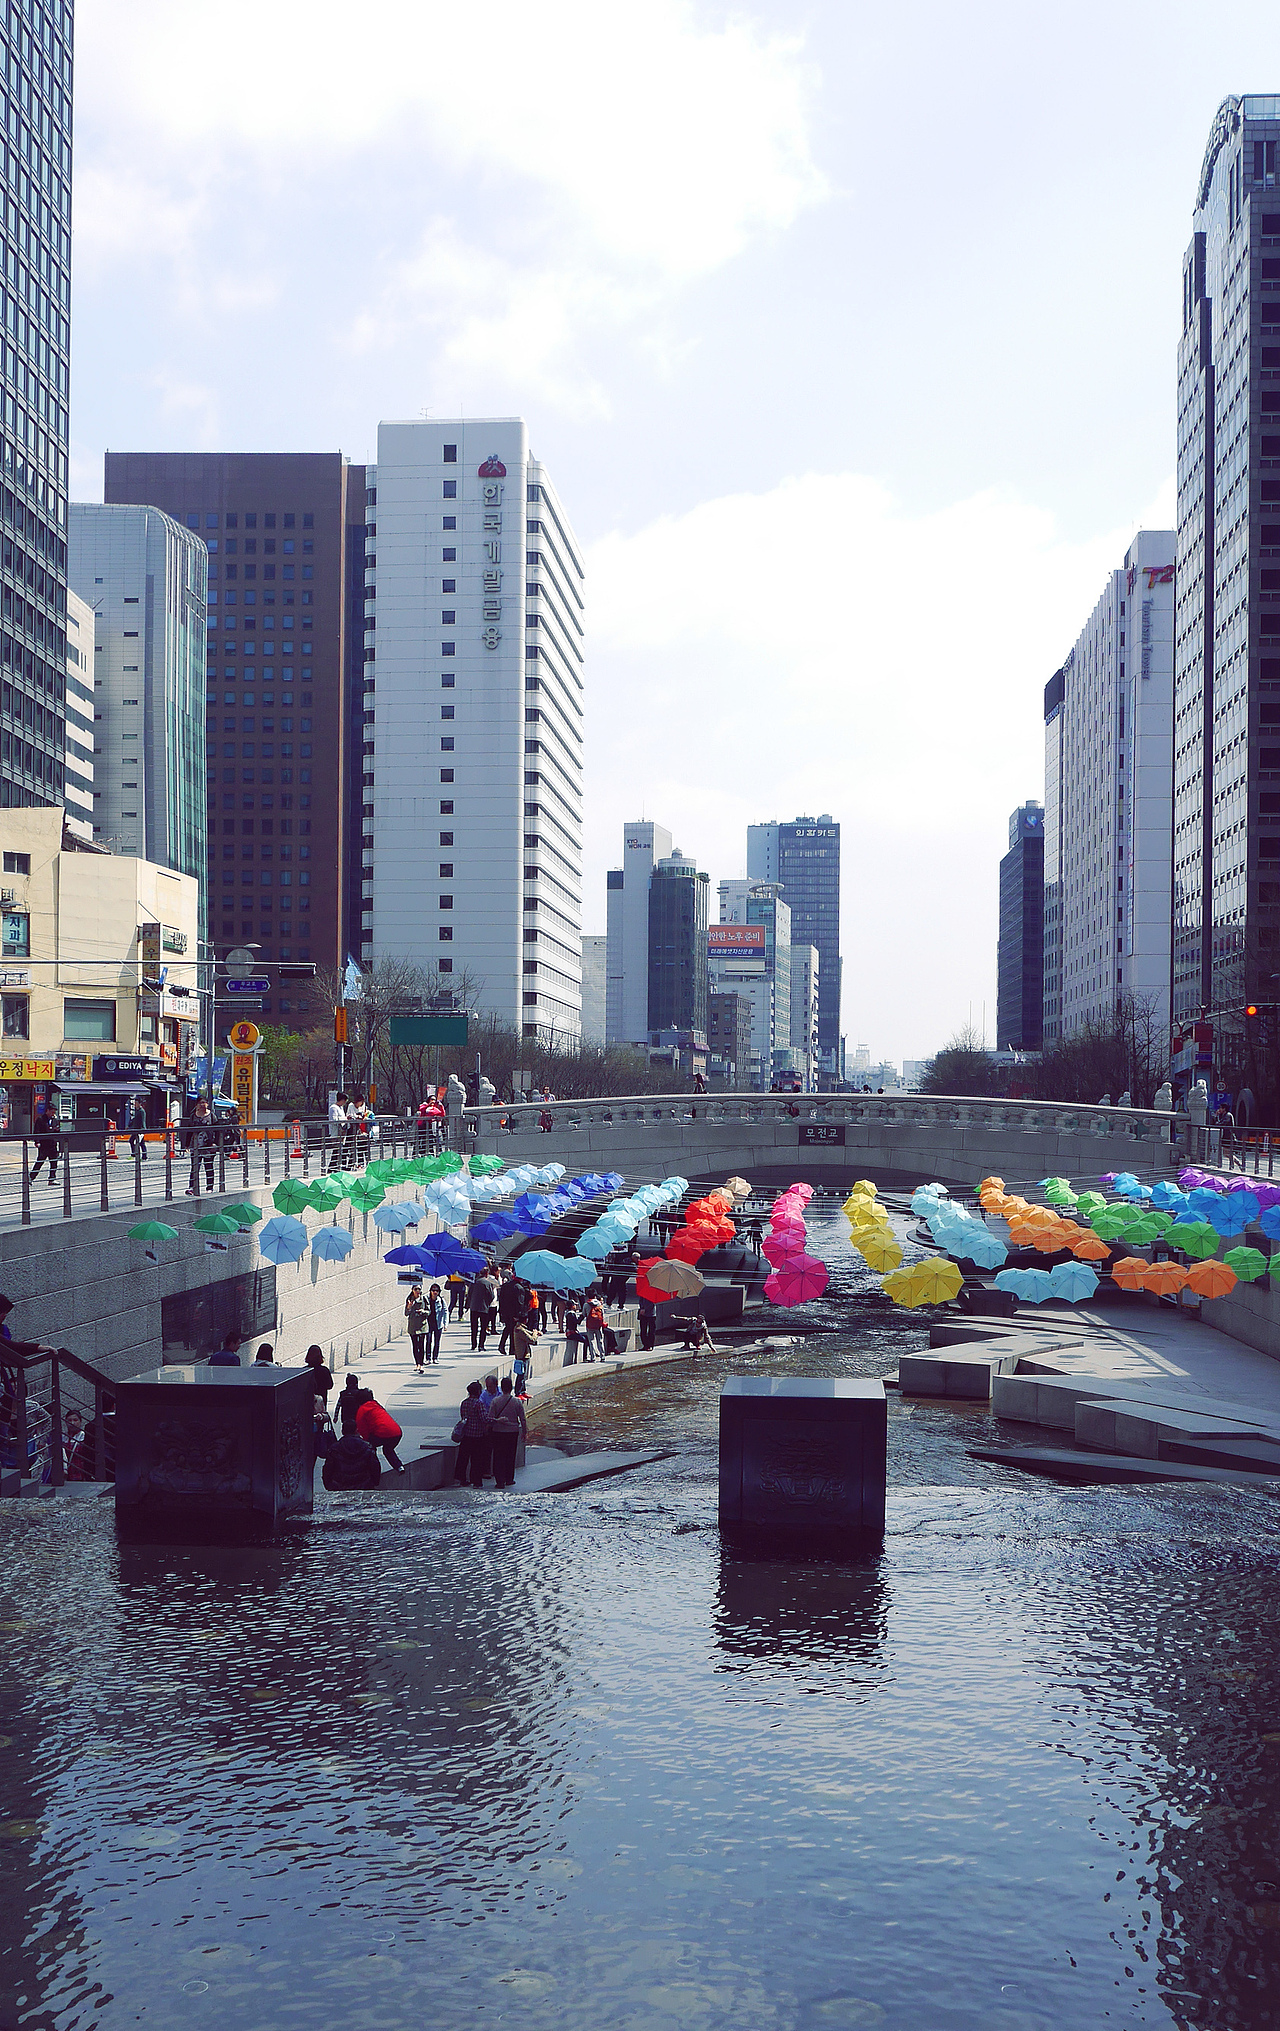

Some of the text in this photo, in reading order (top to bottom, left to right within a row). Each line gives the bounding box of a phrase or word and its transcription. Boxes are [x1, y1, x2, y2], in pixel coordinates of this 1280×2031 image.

[481, 482, 504, 650] 한국개발금융
[0, 1060, 53, 1078] 우정낙지
[118, 1061, 143, 1070] EDIYA
[1217, 1093, 1225, 1102] P
[805, 1128, 838, 1139] 모전교
